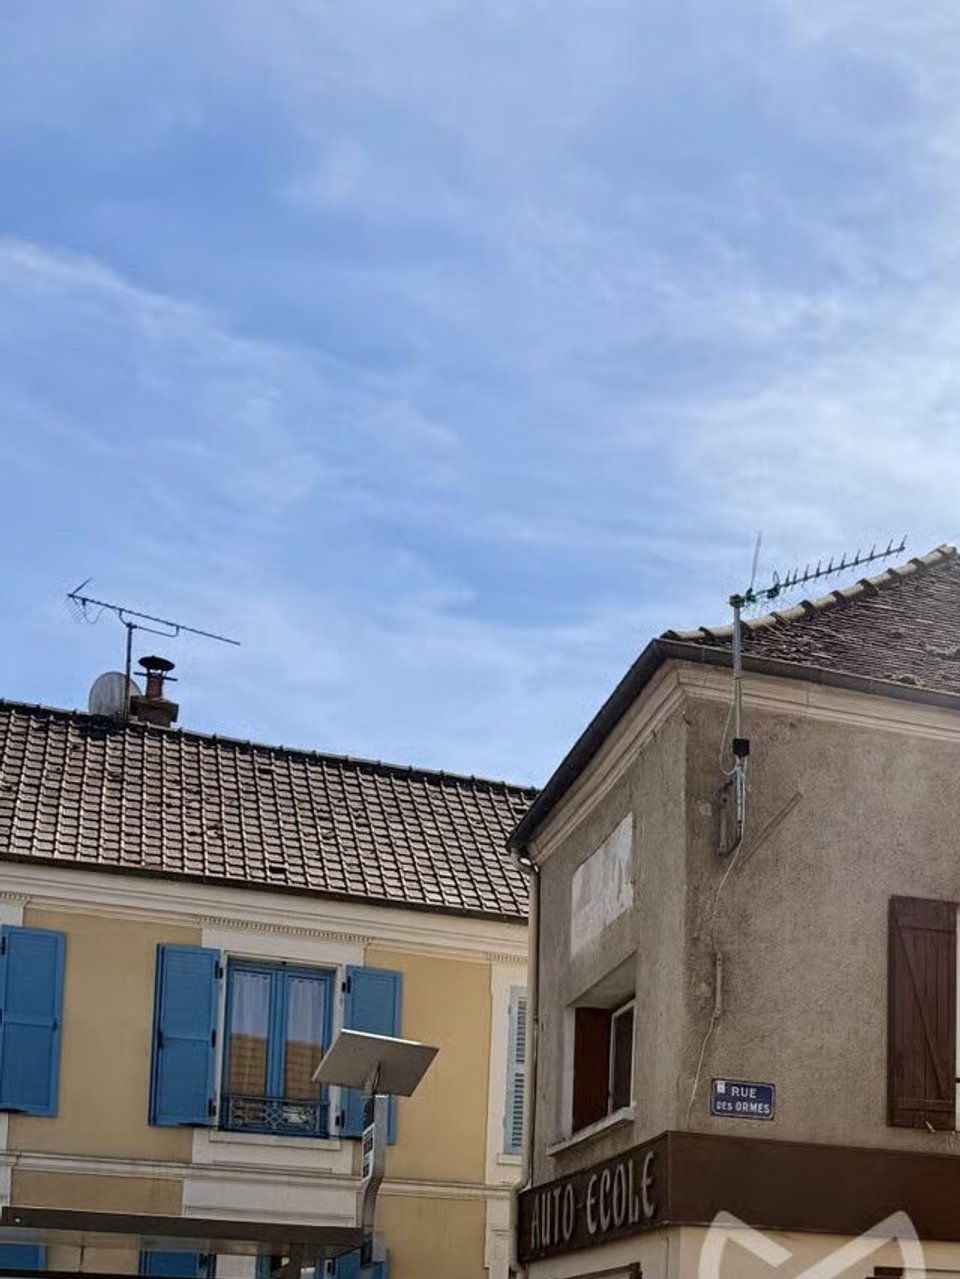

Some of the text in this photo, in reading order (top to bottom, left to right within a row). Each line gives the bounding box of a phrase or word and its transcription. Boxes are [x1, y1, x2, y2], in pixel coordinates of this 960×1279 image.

[731, 1086, 757, 1098] RUE
[716, 1101, 770, 1114] DES ORMES
